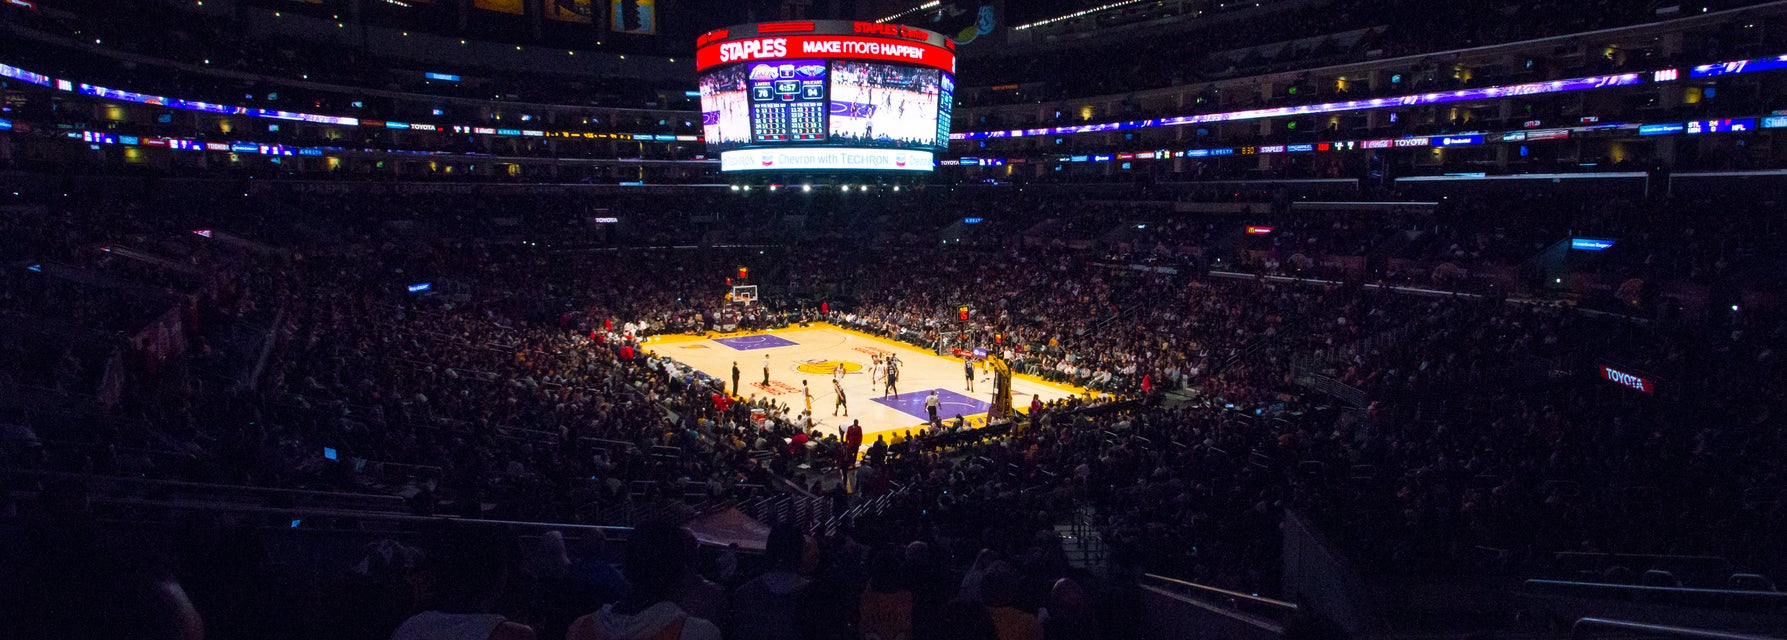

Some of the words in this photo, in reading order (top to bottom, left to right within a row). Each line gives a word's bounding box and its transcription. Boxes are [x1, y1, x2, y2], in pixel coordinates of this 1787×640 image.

[854, 22, 898, 36] STAPLES
[720, 38, 787, 62] STAPLES
[802, 41, 842, 53] MAKE
[844, 41, 879, 54] more
[881, 44, 923, 59] HAPPEN
[758, 90, 768, 98] 78
[779, 84, 796, 92] 4:57
[1395, 138, 1428, 147] TOYOTA
[778, 154, 816, 164] Chevron
[817, 154, 839, 164] with
[840, 153, 890, 166] TECHRON
[1606, 368, 1645, 392] TOYOTA
